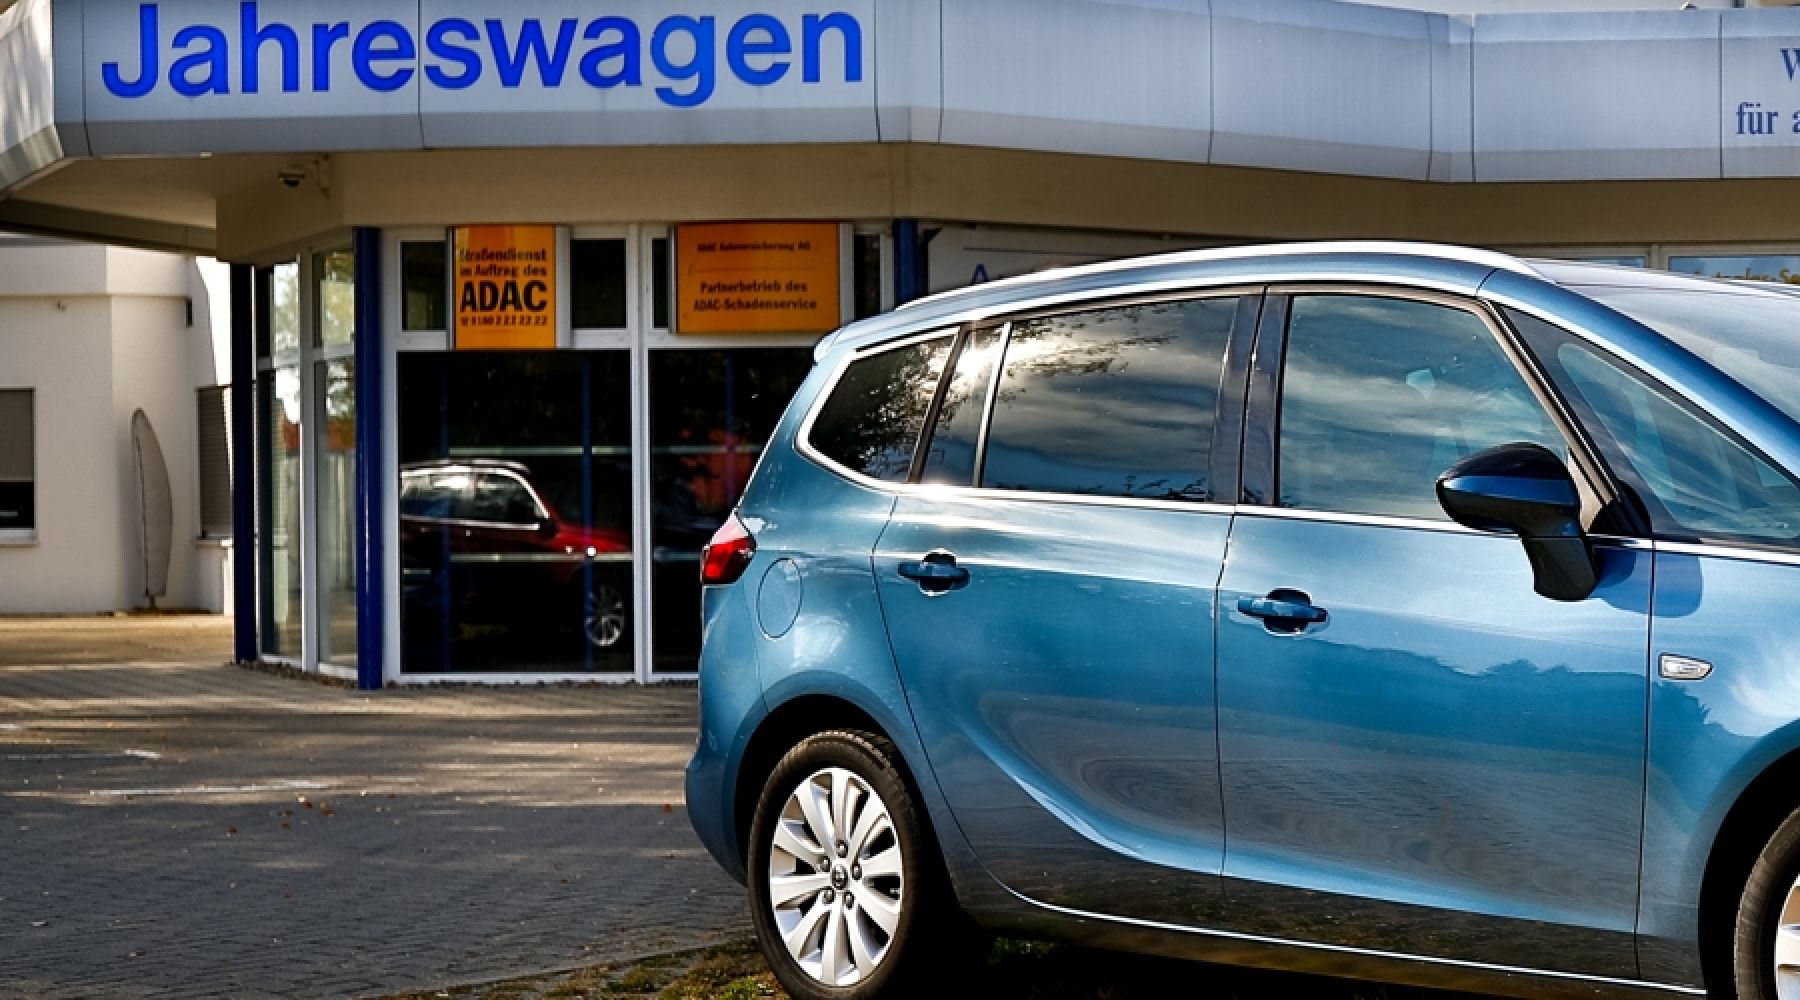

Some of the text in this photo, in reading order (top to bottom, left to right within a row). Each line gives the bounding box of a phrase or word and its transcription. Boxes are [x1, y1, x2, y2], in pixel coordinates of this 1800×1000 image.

[101, 1, 863, 107] Jahreswagen
[1736, 101, 1778, 135] für
[475, 264, 518, 278] Auftrag
[523, 264, 547, 277] des
[460, 280, 548, 312] ADAC
